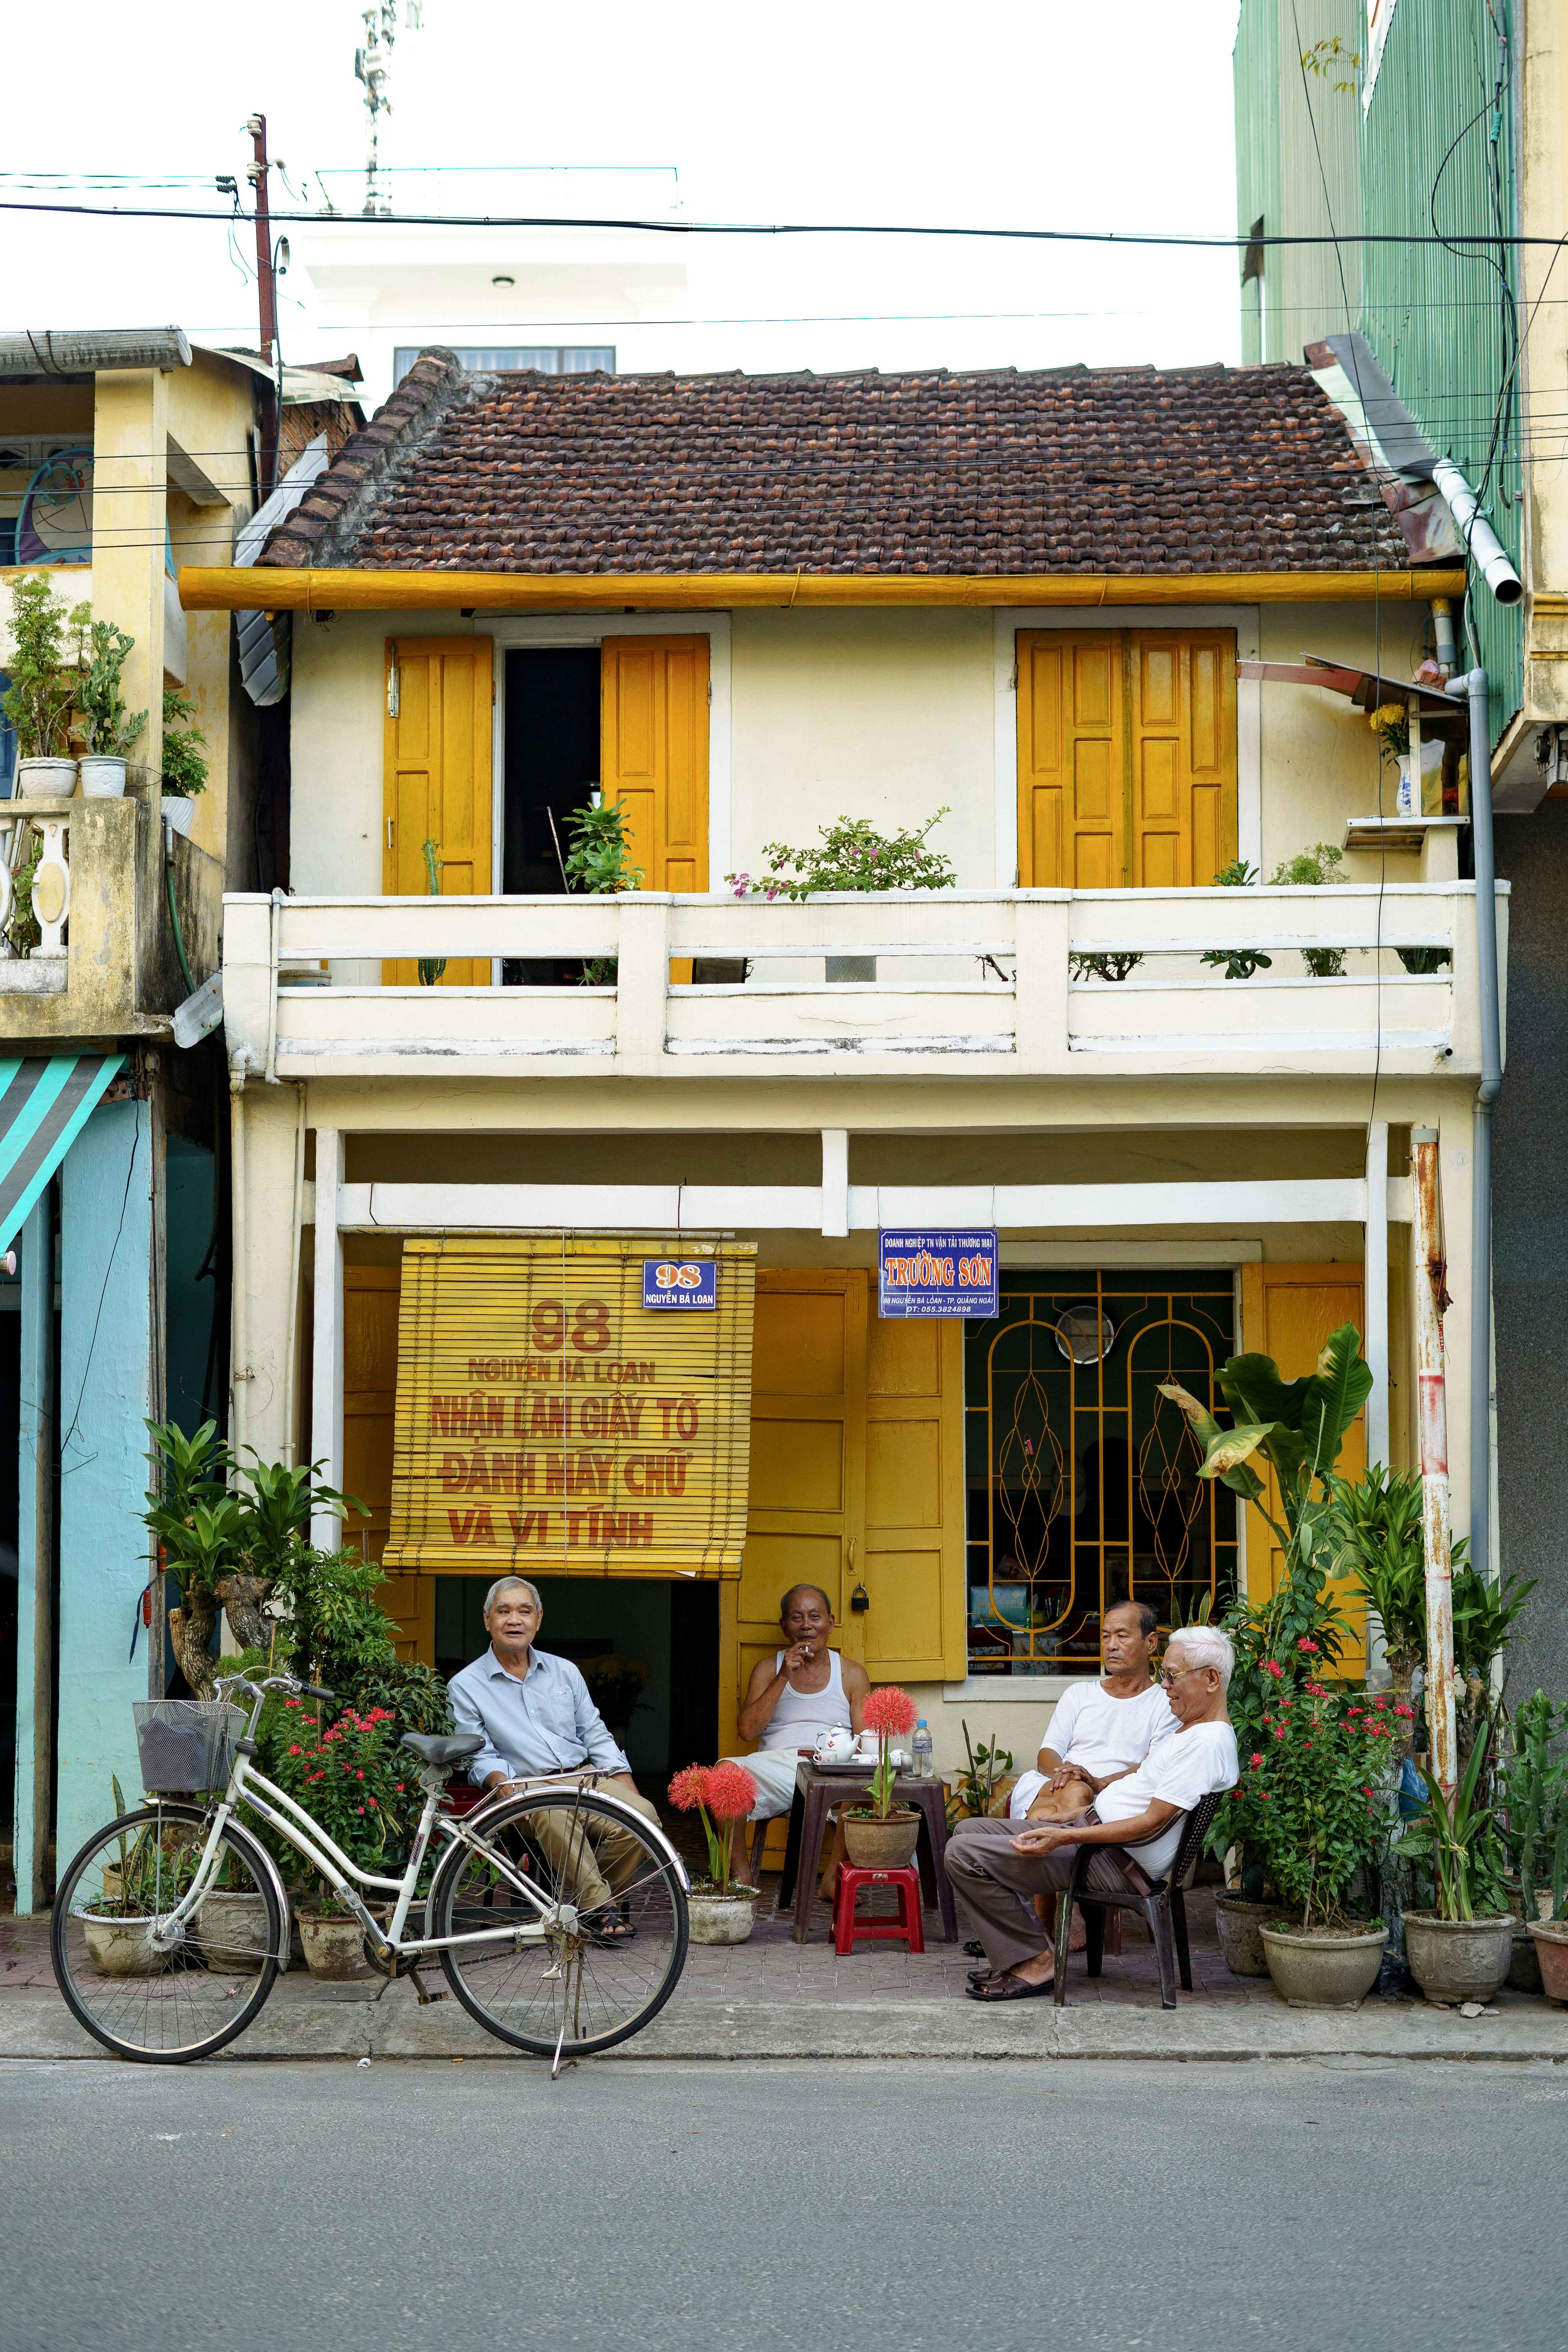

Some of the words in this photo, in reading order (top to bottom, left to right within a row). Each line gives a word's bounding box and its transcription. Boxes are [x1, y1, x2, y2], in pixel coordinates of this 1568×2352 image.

[885, 1238, 903, 1248] DOANH
[905, 1236, 925, 1250] NGHIỆP
[927, 1239, 934, 1248] TN
[936, 1236, 946, 1250] VẬN
[948, 1235, 956, 1248] TẢI
[958, 1237, 980, 1248] THƯƠNG
[982, 1238, 992, 1250] MẠI
[655, 1265, 702, 1289] 98
[885, 1250, 955, 1286] TRƯỜNG
[958, 1253, 992, 1286] SƠN
[646, 1290, 677, 1303] NGUYỄN
[679, 1292, 690, 1303] BÁ
[693, 1295, 713, 1304] LOAN
[892, 1295, 915, 1304] NGUYỄN
[957, 1296, 977, 1304] QUẢNG
[979, 1296, 993, 1304] NGÃI
[532, 1300, 612, 1354] 98
[468, 1357, 551, 1382] NGUYỄN
[559, 1356, 586, 1382] BÁ
[594, 1361, 656, 1383] LOAN
[432, 1389, 504, 1444] NHẬN
[514, 1390, 572, 1439] LÀM
[581, 1392, 645, 1439] GIẤY
[437, 1446, 537, 1495] ĐÁNH
[546, 1447, 613, 1495] MÁY
[624, 1448, 693, 1496] CHỮ
[448, 1503, 497, 1544] VÀ
[507, 1510, 547, 1545] VI
[560, 1504, 654, 1546] TÍNH
